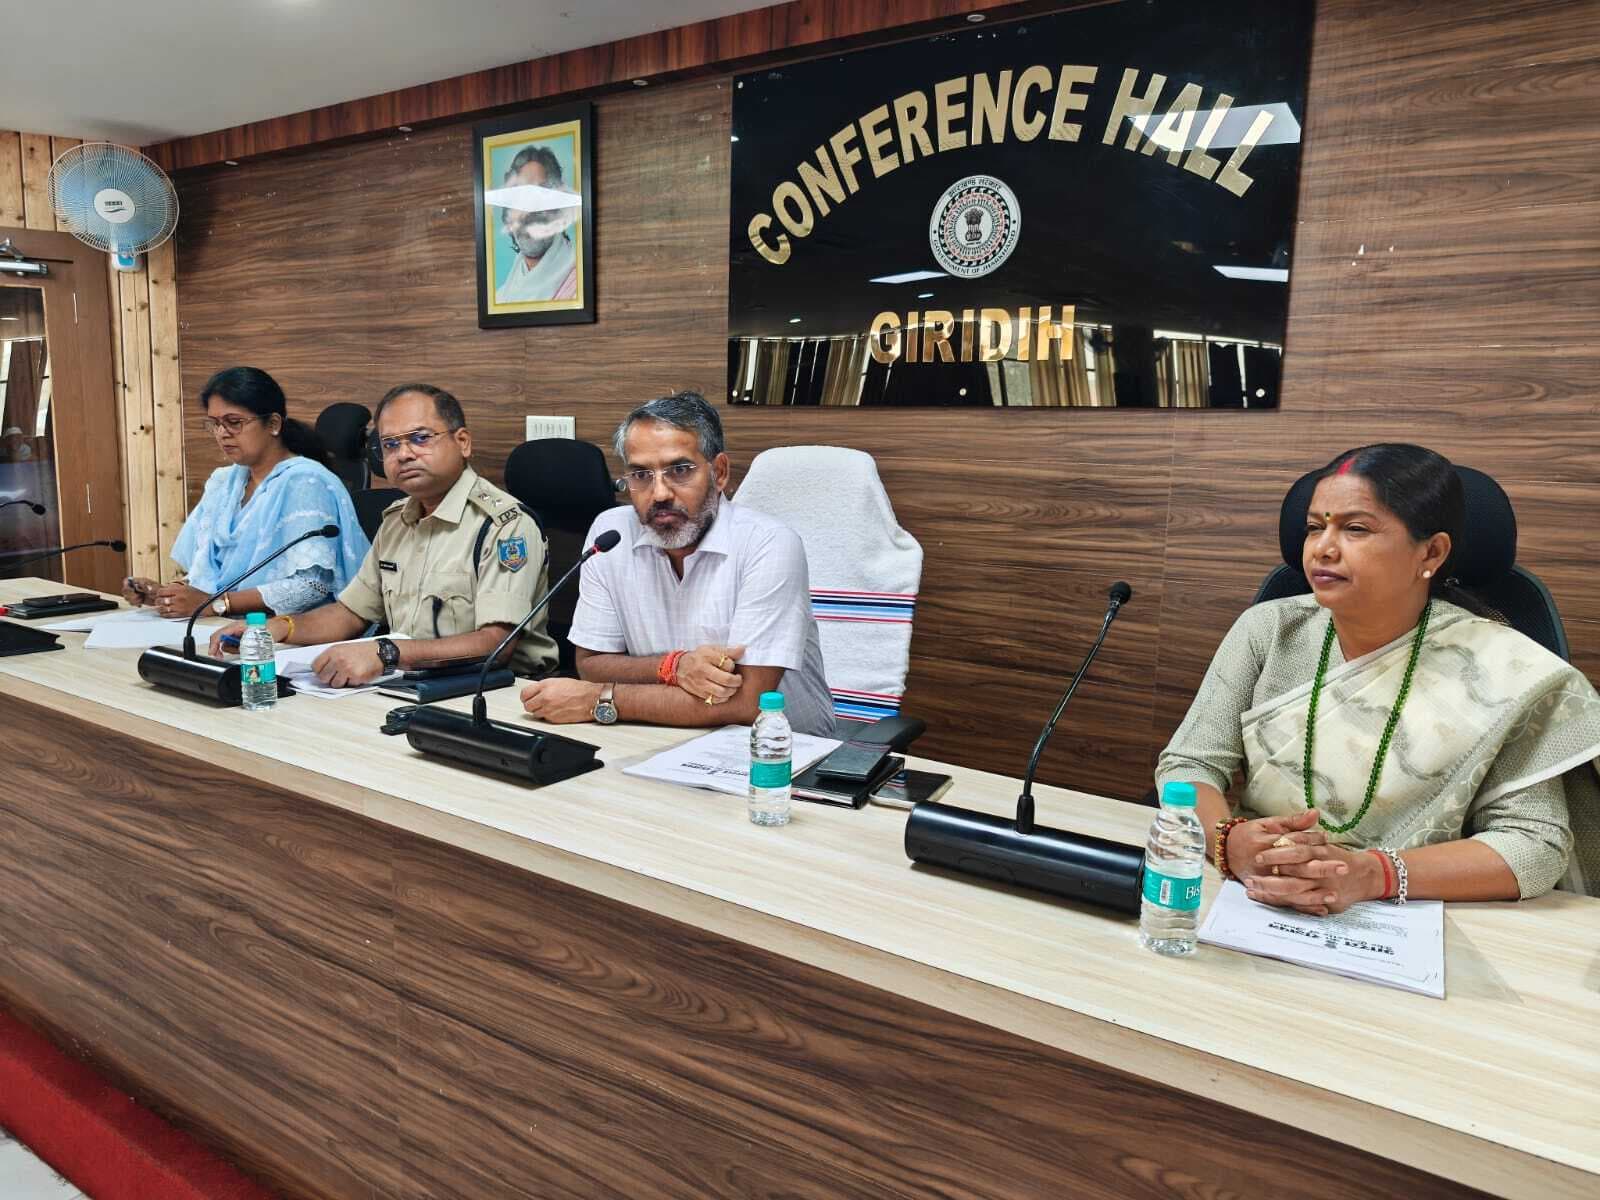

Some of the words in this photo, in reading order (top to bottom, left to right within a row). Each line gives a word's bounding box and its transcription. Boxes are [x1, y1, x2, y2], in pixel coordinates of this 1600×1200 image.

[747, 64, 1098, 265] CONFERENCE
[1102, 68, 1274, 198] HALL
[933, 239, 969, 274] GOVERNMENT
[982, 230, 1016, 272] JHARKHAND
[869, 305, 1076, 364] GIRIDIH
